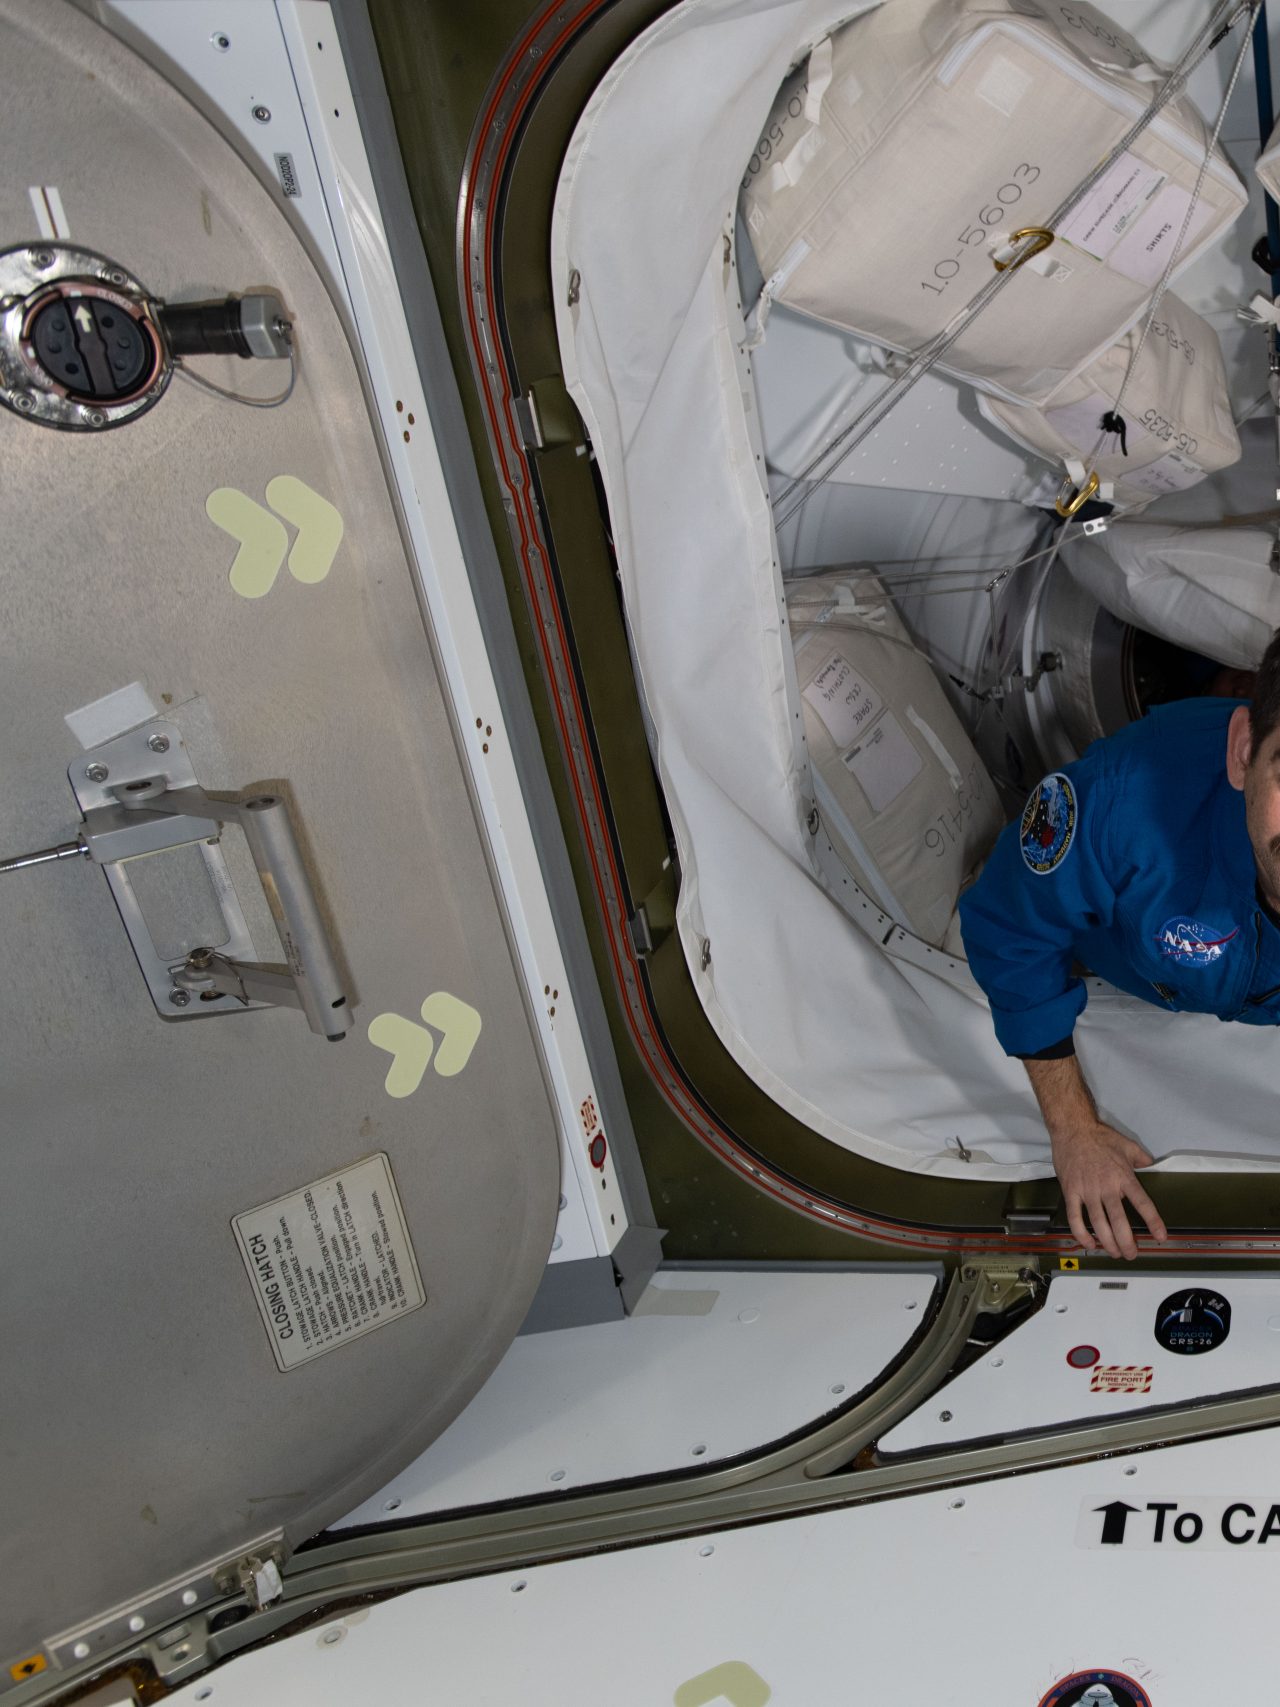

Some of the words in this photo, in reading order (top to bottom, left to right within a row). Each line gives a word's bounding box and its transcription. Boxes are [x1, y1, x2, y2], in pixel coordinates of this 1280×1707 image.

[919, 158, 1040, 296] 1.0-5603
[1138, 410, 1197, 455] 0.5-5235
[851, 696, 872, 726] SPARE
[1163, 928, 1223, 956] NASA
[302, 1189, 326, 1246] VALVE-CLOSED.
[343, 1209, 356, 1234] LATCH
[378, 1218, 391, 1244] Stowed
[247, 1232, 276, 1283] HATCH
[270, 1234, 283, 1255] Push.
[283, 1236, 294, 1251] Pull
[338, 1232, 353, 1261] Engaged
[352, 1241, 362, 1257] Turn
[370, 1230, 385, 1263] LATCHED.
[279, 1258, 294, 1288] BUTTON
[289, 1255, 304, 1283] HANDLE
[319, 1244, 340, 1293] EQUALIZATION
[336, 1261, 349, 1285] LATCH
[358, 1261, 371, 1288] HANDLE
[386, 1248, 399, 1275] HANDLE
[316, 1269, 330, 1296] Aligned.
[348, 1265, 362, 1293] HANDLE
[380, 1267, 396, 1302] INDICATOR
[393, 1274, 405, 1297] CRANK
[287, 1286, 301, 1311] LATCH
[298, 1282, 311, 1306] LATCH
[311, 1288, 322, 1306] Push
[333, 1291, 349, 1325] PRESSURE
[344, 1289, 359, 1320] RATCHET
[356, 1292, 369, 1315] CRANK
[365, 1287, 378, 1311] CRANK
[263, 1281, 294, 1341] CLOSING
[305, 1305, 321, 1338] STOWAGE
[318, 1309, 331, 1333] HATCH
[325, 1299, 340, 1329] ARROWS
[294, 1309, 311, 1343] STOWAGE
[1146, 1502, 1203, 1543] To
